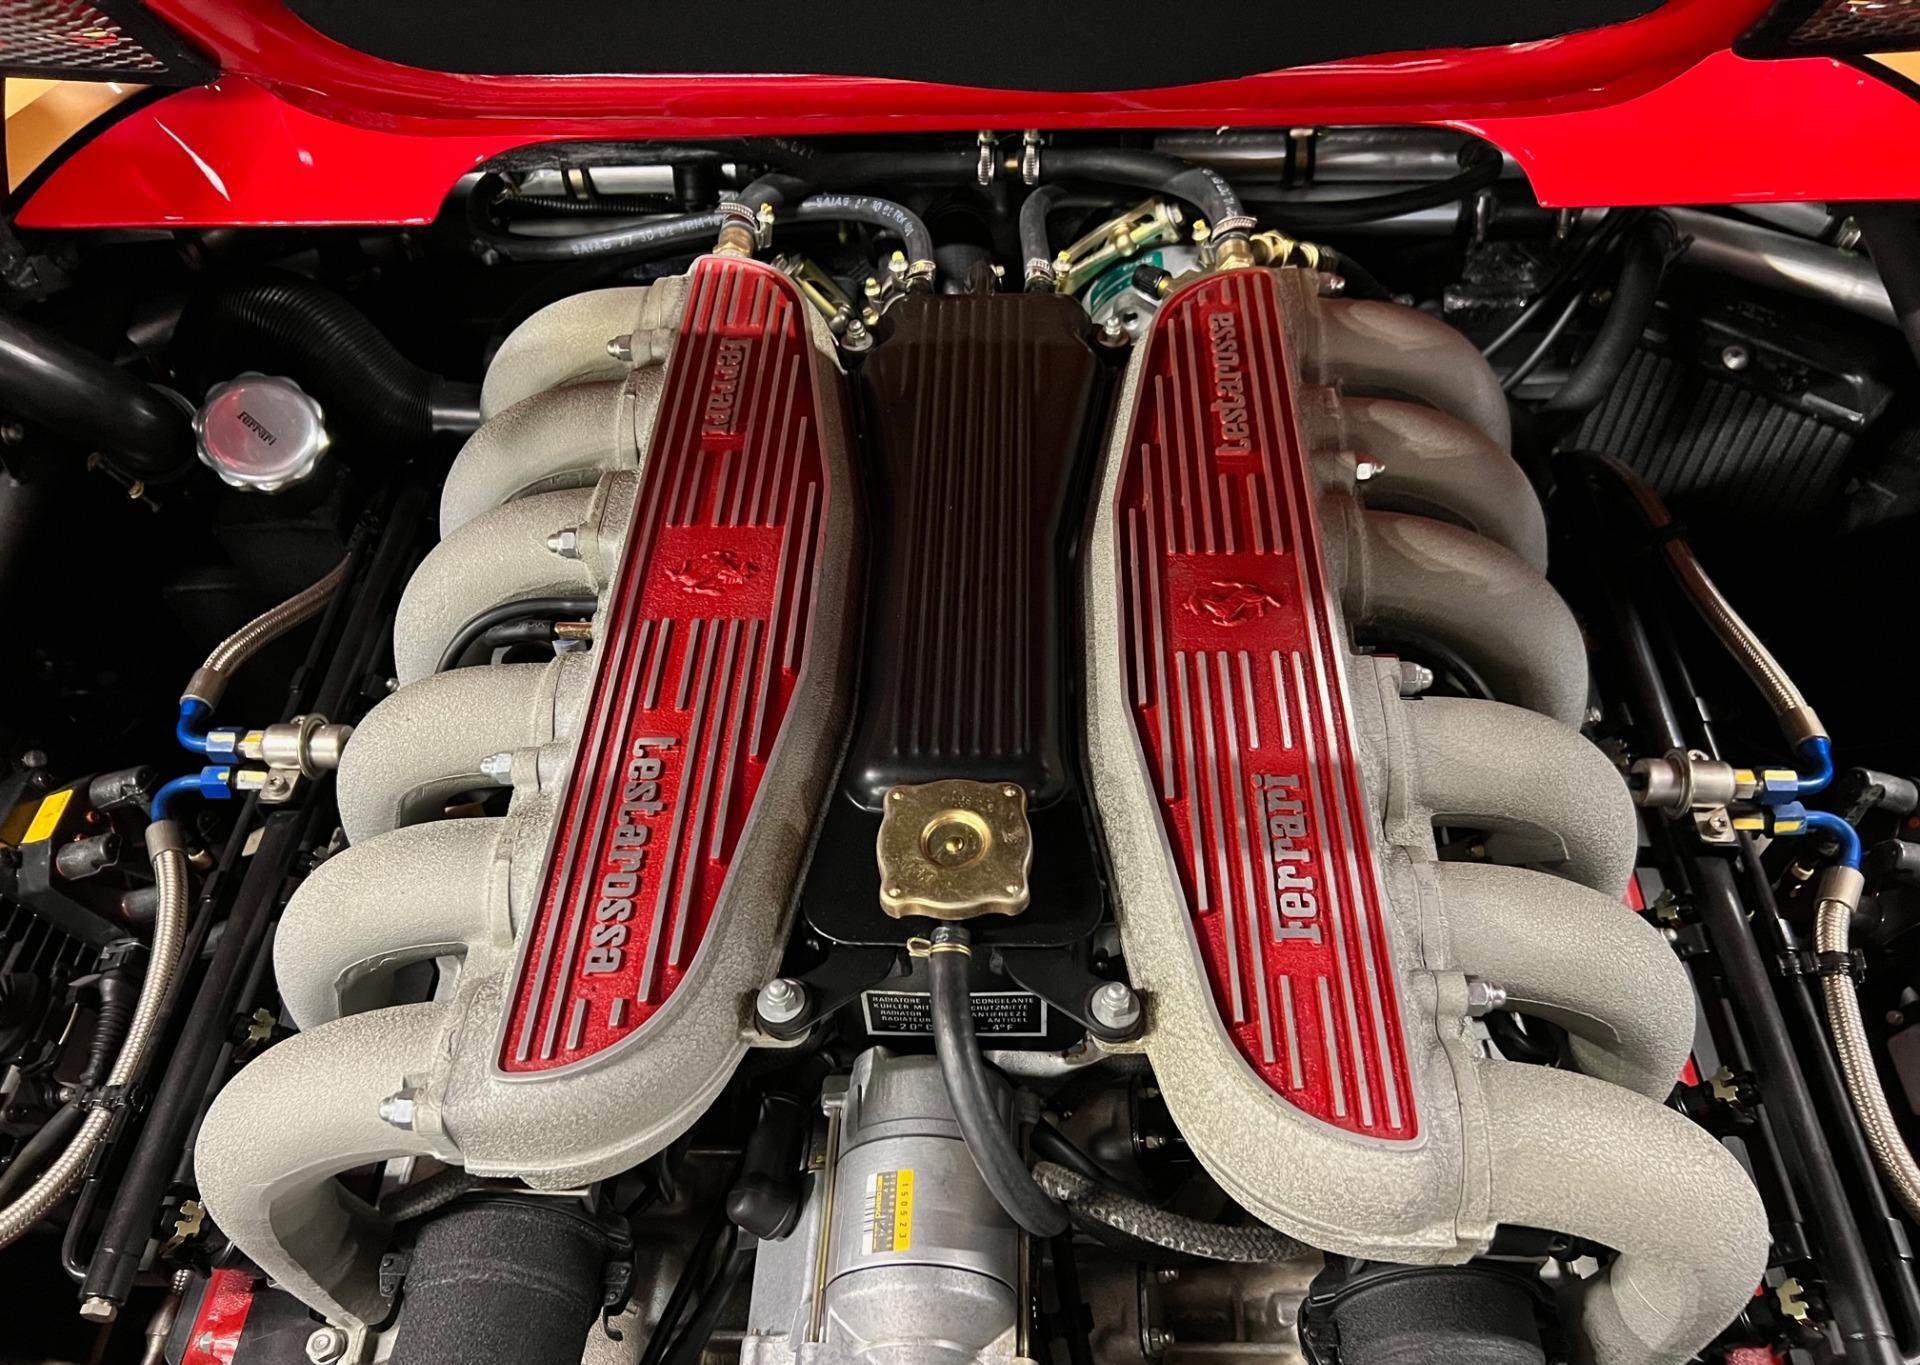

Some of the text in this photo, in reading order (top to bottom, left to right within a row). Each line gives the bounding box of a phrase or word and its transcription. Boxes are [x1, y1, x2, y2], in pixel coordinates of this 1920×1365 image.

[237, 411, 277, 446] Ferrari
[702, 338, 753, 436] Ferrari
[1251, 773, 1322, 944] Ferrari
